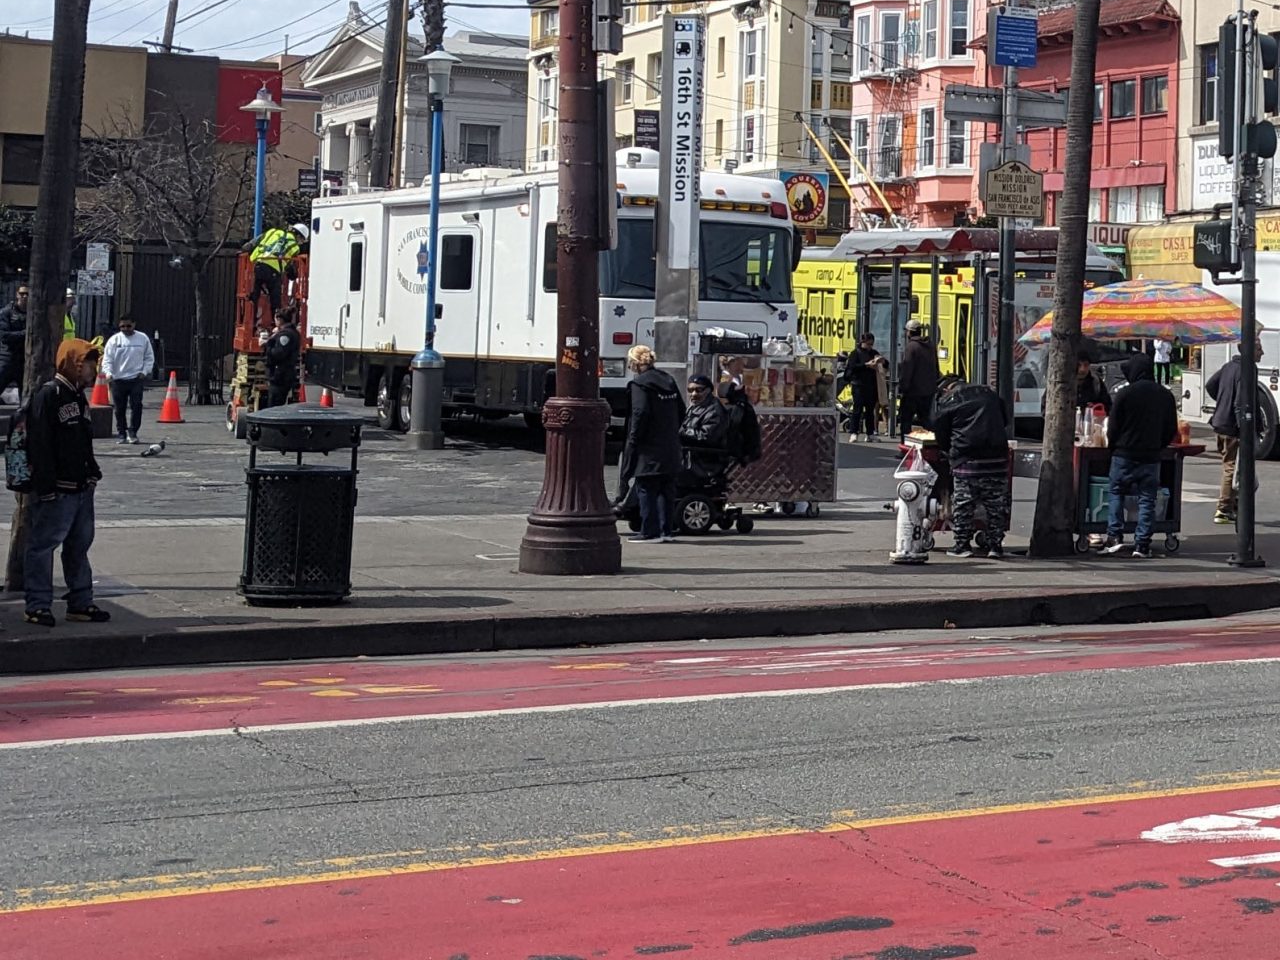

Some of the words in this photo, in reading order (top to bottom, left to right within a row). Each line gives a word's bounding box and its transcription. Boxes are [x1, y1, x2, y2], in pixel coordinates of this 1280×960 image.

[677, 67, 692, 104] 16th
[677, 111, 691, 129] St
[674, 135, 690, 202] Mission
[786, 175, 822, 194] AQUERIA
[993, 173, 1013, 182] MISSION
[1014, 174, 1036, 184] DOLORES
[1002, 183, 1027, 193] MISSION
[1199, 181, 1233, 194] COFFE
[988, 193, 997, 202] SAN
[998, 193, 1022, 204] FRANCISCO
[406, 226, 430, 244] FRANCISC
[1162, 237, 1187, 250] CASA
[1171, 252, 1189, 261] SUPER
[816, 270, 834, 284] ramp
[799, 308, 844, 340] finance
